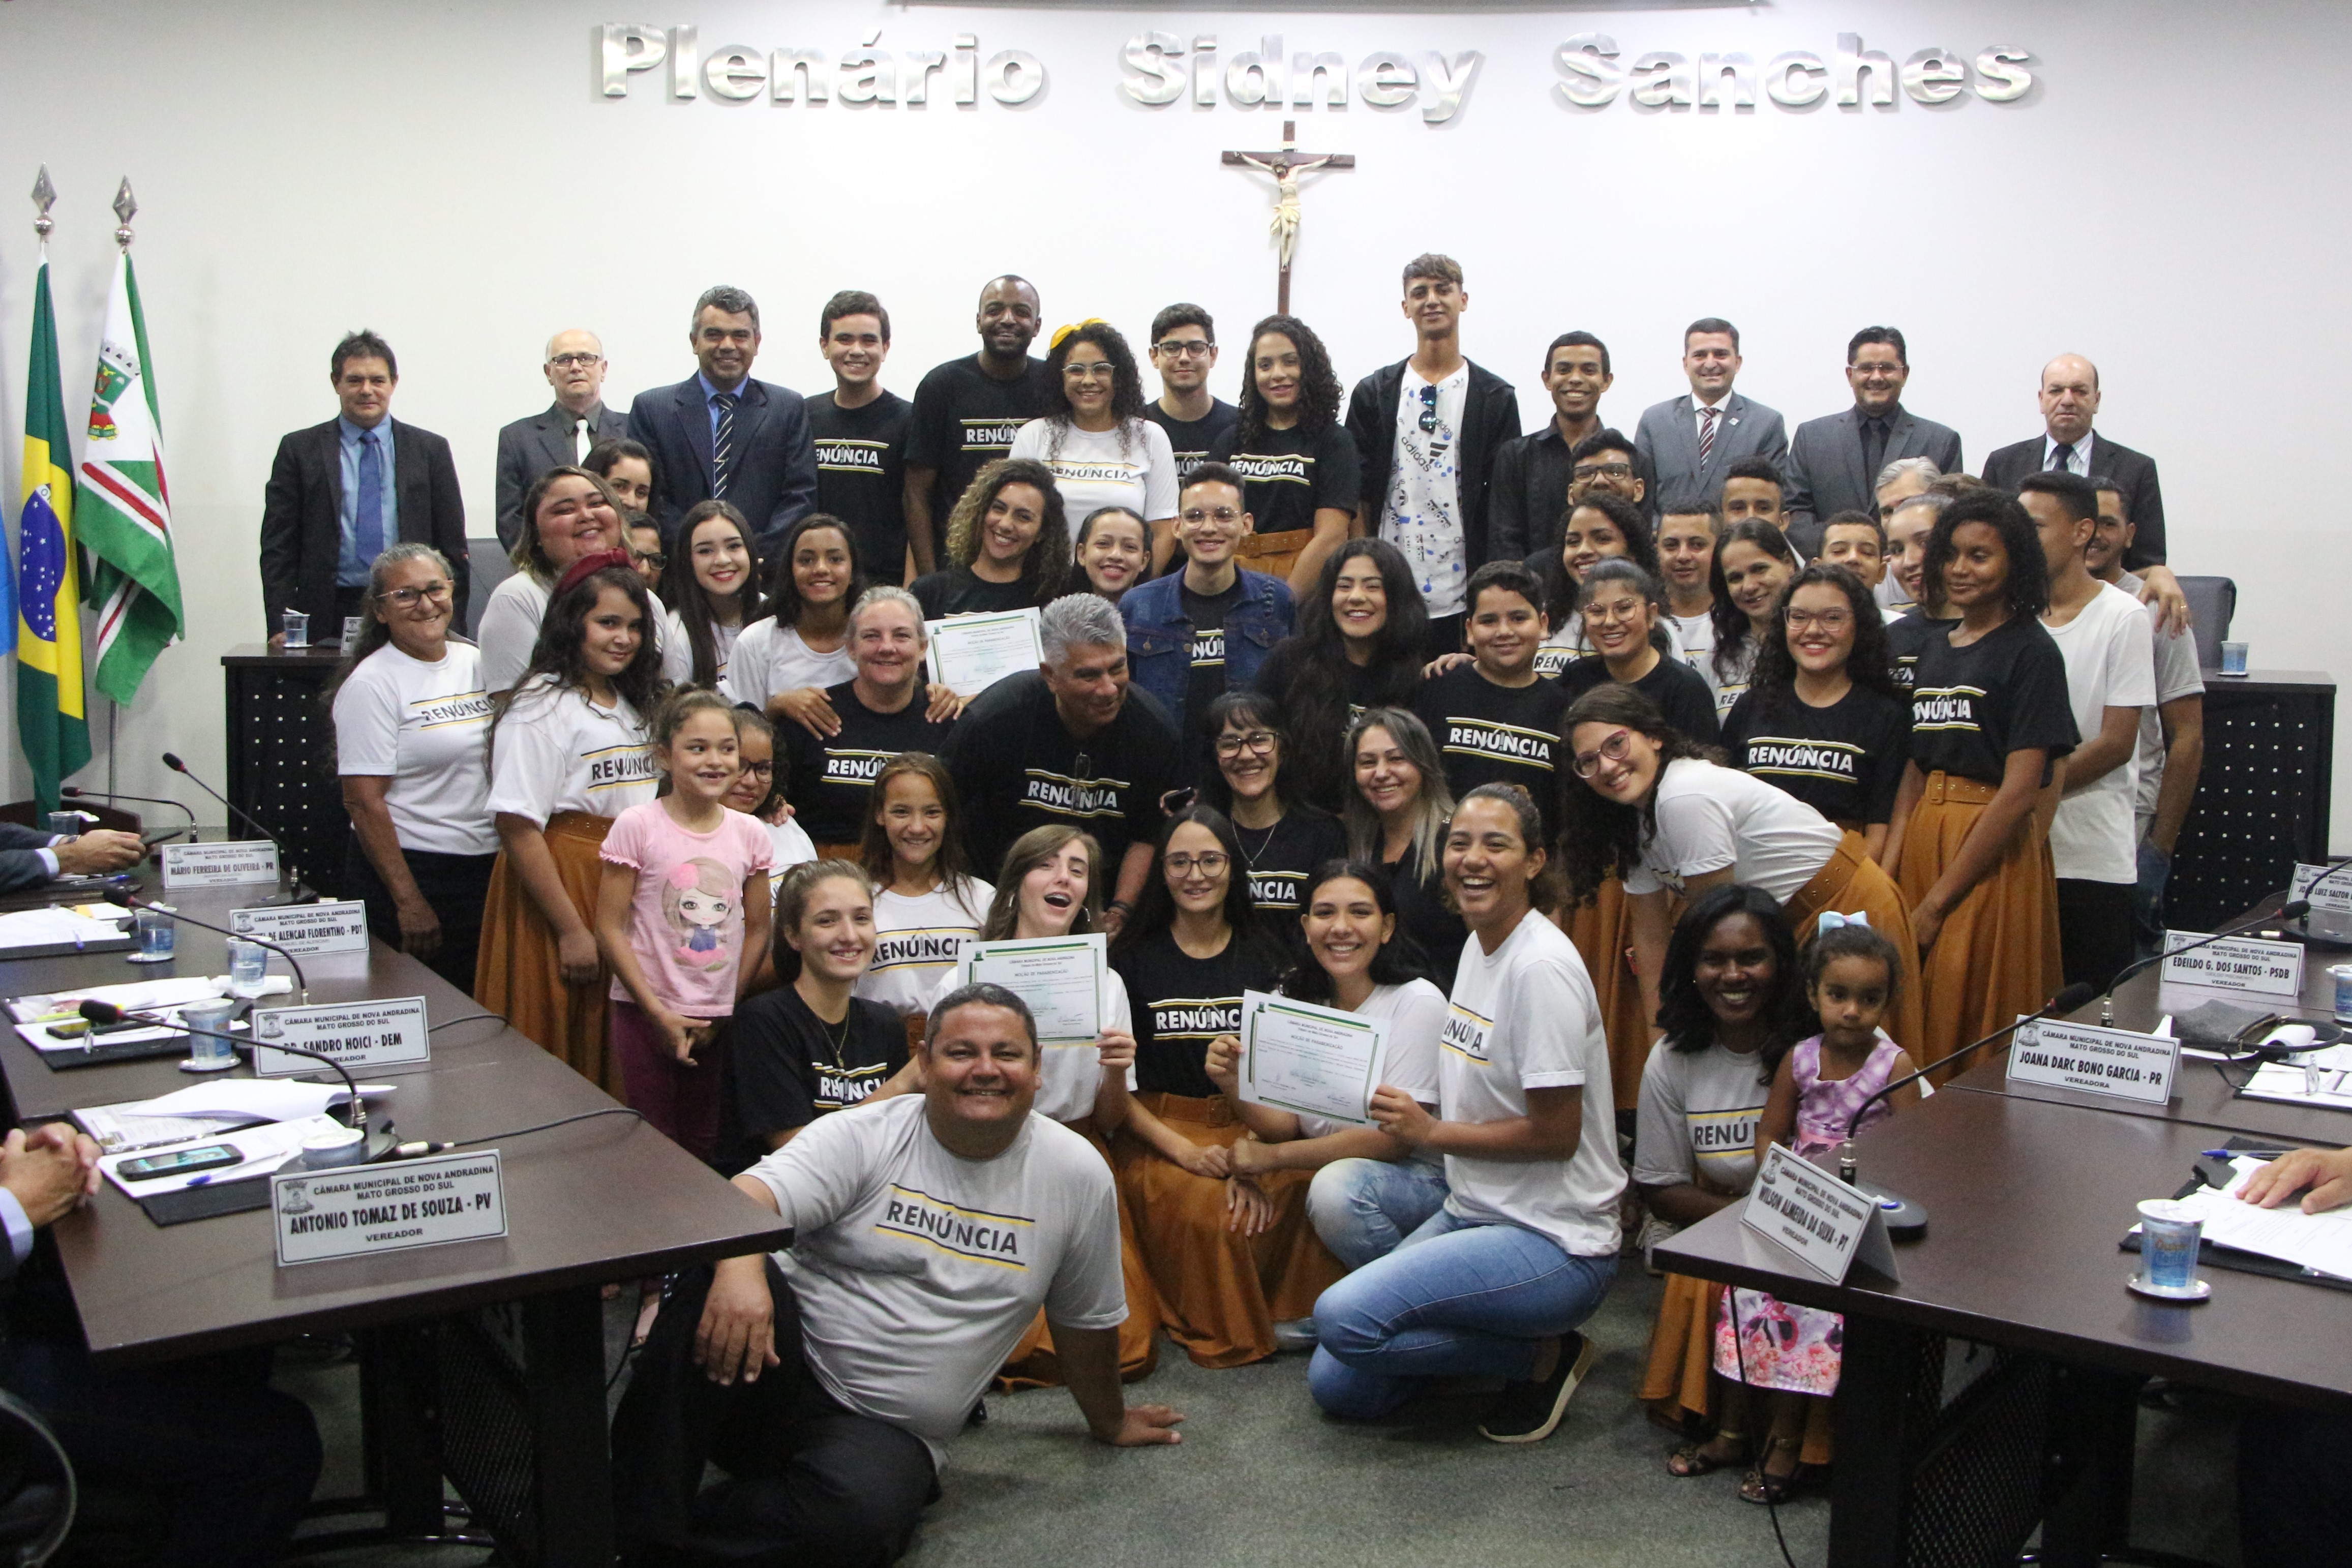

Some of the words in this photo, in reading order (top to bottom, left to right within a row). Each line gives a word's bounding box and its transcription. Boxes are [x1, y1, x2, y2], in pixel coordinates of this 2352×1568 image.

[601, 22, 1042, 104] Plenário
[1123, 32, 1479, 122] Sidney
[1559, 32, 2032, 106] Sanches
[1401, 437, 1431, 472] adidas
[171, 865, 191, 875] MÁRIO
[193, 865, 221, 873] FERREIRA
[233, 862, 260, 871] OLIVEIRA
[279, 929, 307, 941] ALENCAR
[308, 927, 345, 939] FLORENTINO
[351, 924, 363, 934] PDT
[2173, 957, 2204, 969] EDEILDO
[2206, 960, 2213, 971] G.
[2216, 961, 2231, 972] DOS
[2233, 963, 2262, 975] SANTOS
[2270, 967, 2289, 979] PSDB
[315, 1014, 350, 1022] MUNICIPAL
[382, 1008, 420, 1016] ANDRADINA
[346, 1036, 372, 1050] HOICI
[381, 1033, 402, 1046] DEM
[2042, 1031, 2067, 1040] CÂMARA
[2069, 1035, 2102, 1046] MUNICIPAL
[2115, 1041, 2132, 1050] NOVA
[2133, 1045, 2170, 1056] ANDRADINA
[2089, 1046, 2115, 1055] GROSSO
[2019, 1050, 2048, 1067] JOANA
[2051, 1055, 2075, 1072] DARC
[2077, 1060, 2103, 1076] BONO
[2106, 1065, 2139, 1082] GARCIA
[2149, 1072, 2162, 1085] PR
[2064, 1076, 2110, 1089] VEREADORA
[313, 1183, 351, 1195] CÂMARA
[353, 1178, 402, 1191] MUNICIPAL
[404, 1175, 416, 1184] DE
[418, 1172, 441, 1182] NOVA
[444, 1166, 494, 1180] ANDRADINA
[357, 1190, 382, 1200] MATO
[385, 1186, 421, 1196] GROSSO
[423, 1184, 436, 1192] DO
[438, 1181, 455, 1190] SUL
[290, 1213, 348, 1234] ANTONIO
[352, 1204, 398, 1226] TOMAZ
[402, 1202, 417, 1220] DE
[421, 1197, 463, 1217] SOUZA
[476, 1193, 491, 1211] PV
[1758, 1184, 1783, 1211] WILSON
[1781, 1198, 1809, 1227] ALMEIDA
[1806, 1215, 1819, 1233] DA
[1816, 1221, 1836, 1245] SILVA
[1836, 1233, 1849, 1252] PT
[366, 1228, 423, 1242] VEREADOR
[887, 1200, 1017, 1254] RENÚNCIA
[1783, 1226, 1808, 1247] VEREADOR
